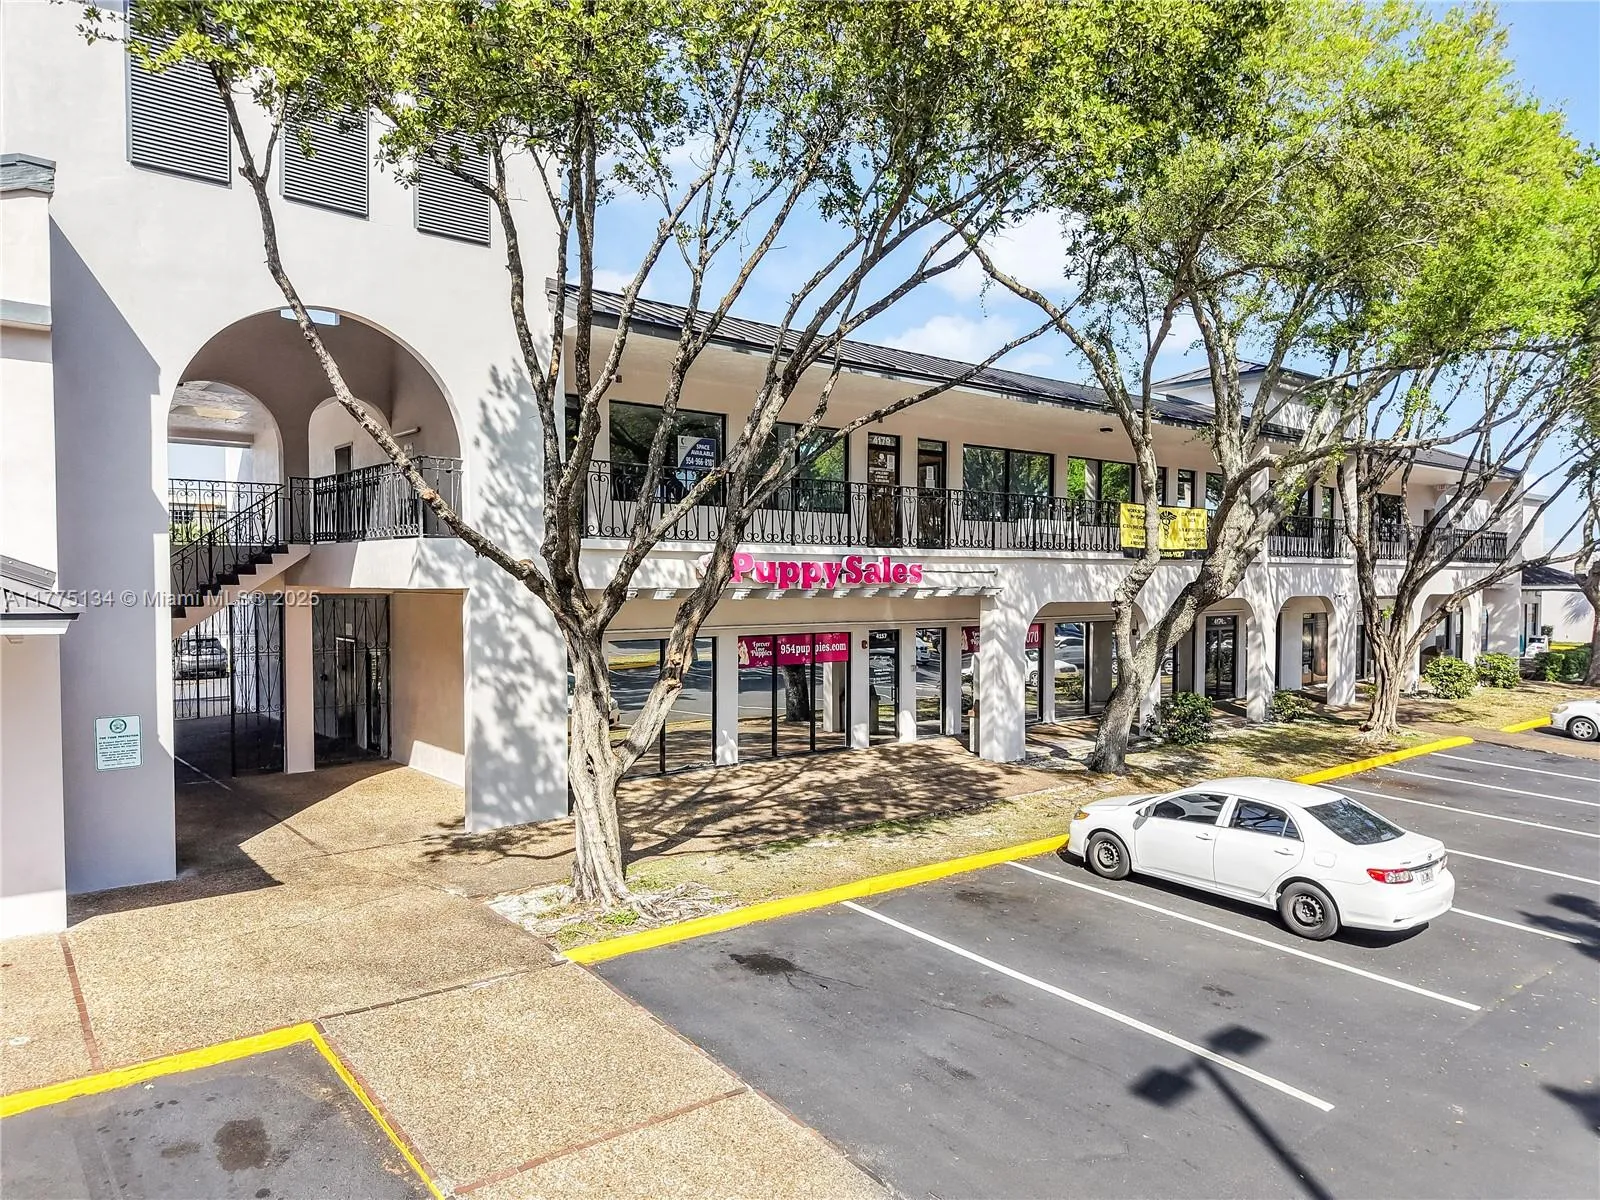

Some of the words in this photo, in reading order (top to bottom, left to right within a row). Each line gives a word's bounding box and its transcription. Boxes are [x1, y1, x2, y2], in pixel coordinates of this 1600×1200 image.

[696, 443, 711, 451] SPACE
[690, 449, 715, 458] AVAILABLE
[752, 640, 771, 648] Forever
[750, 649, 773, 659] Puppies
